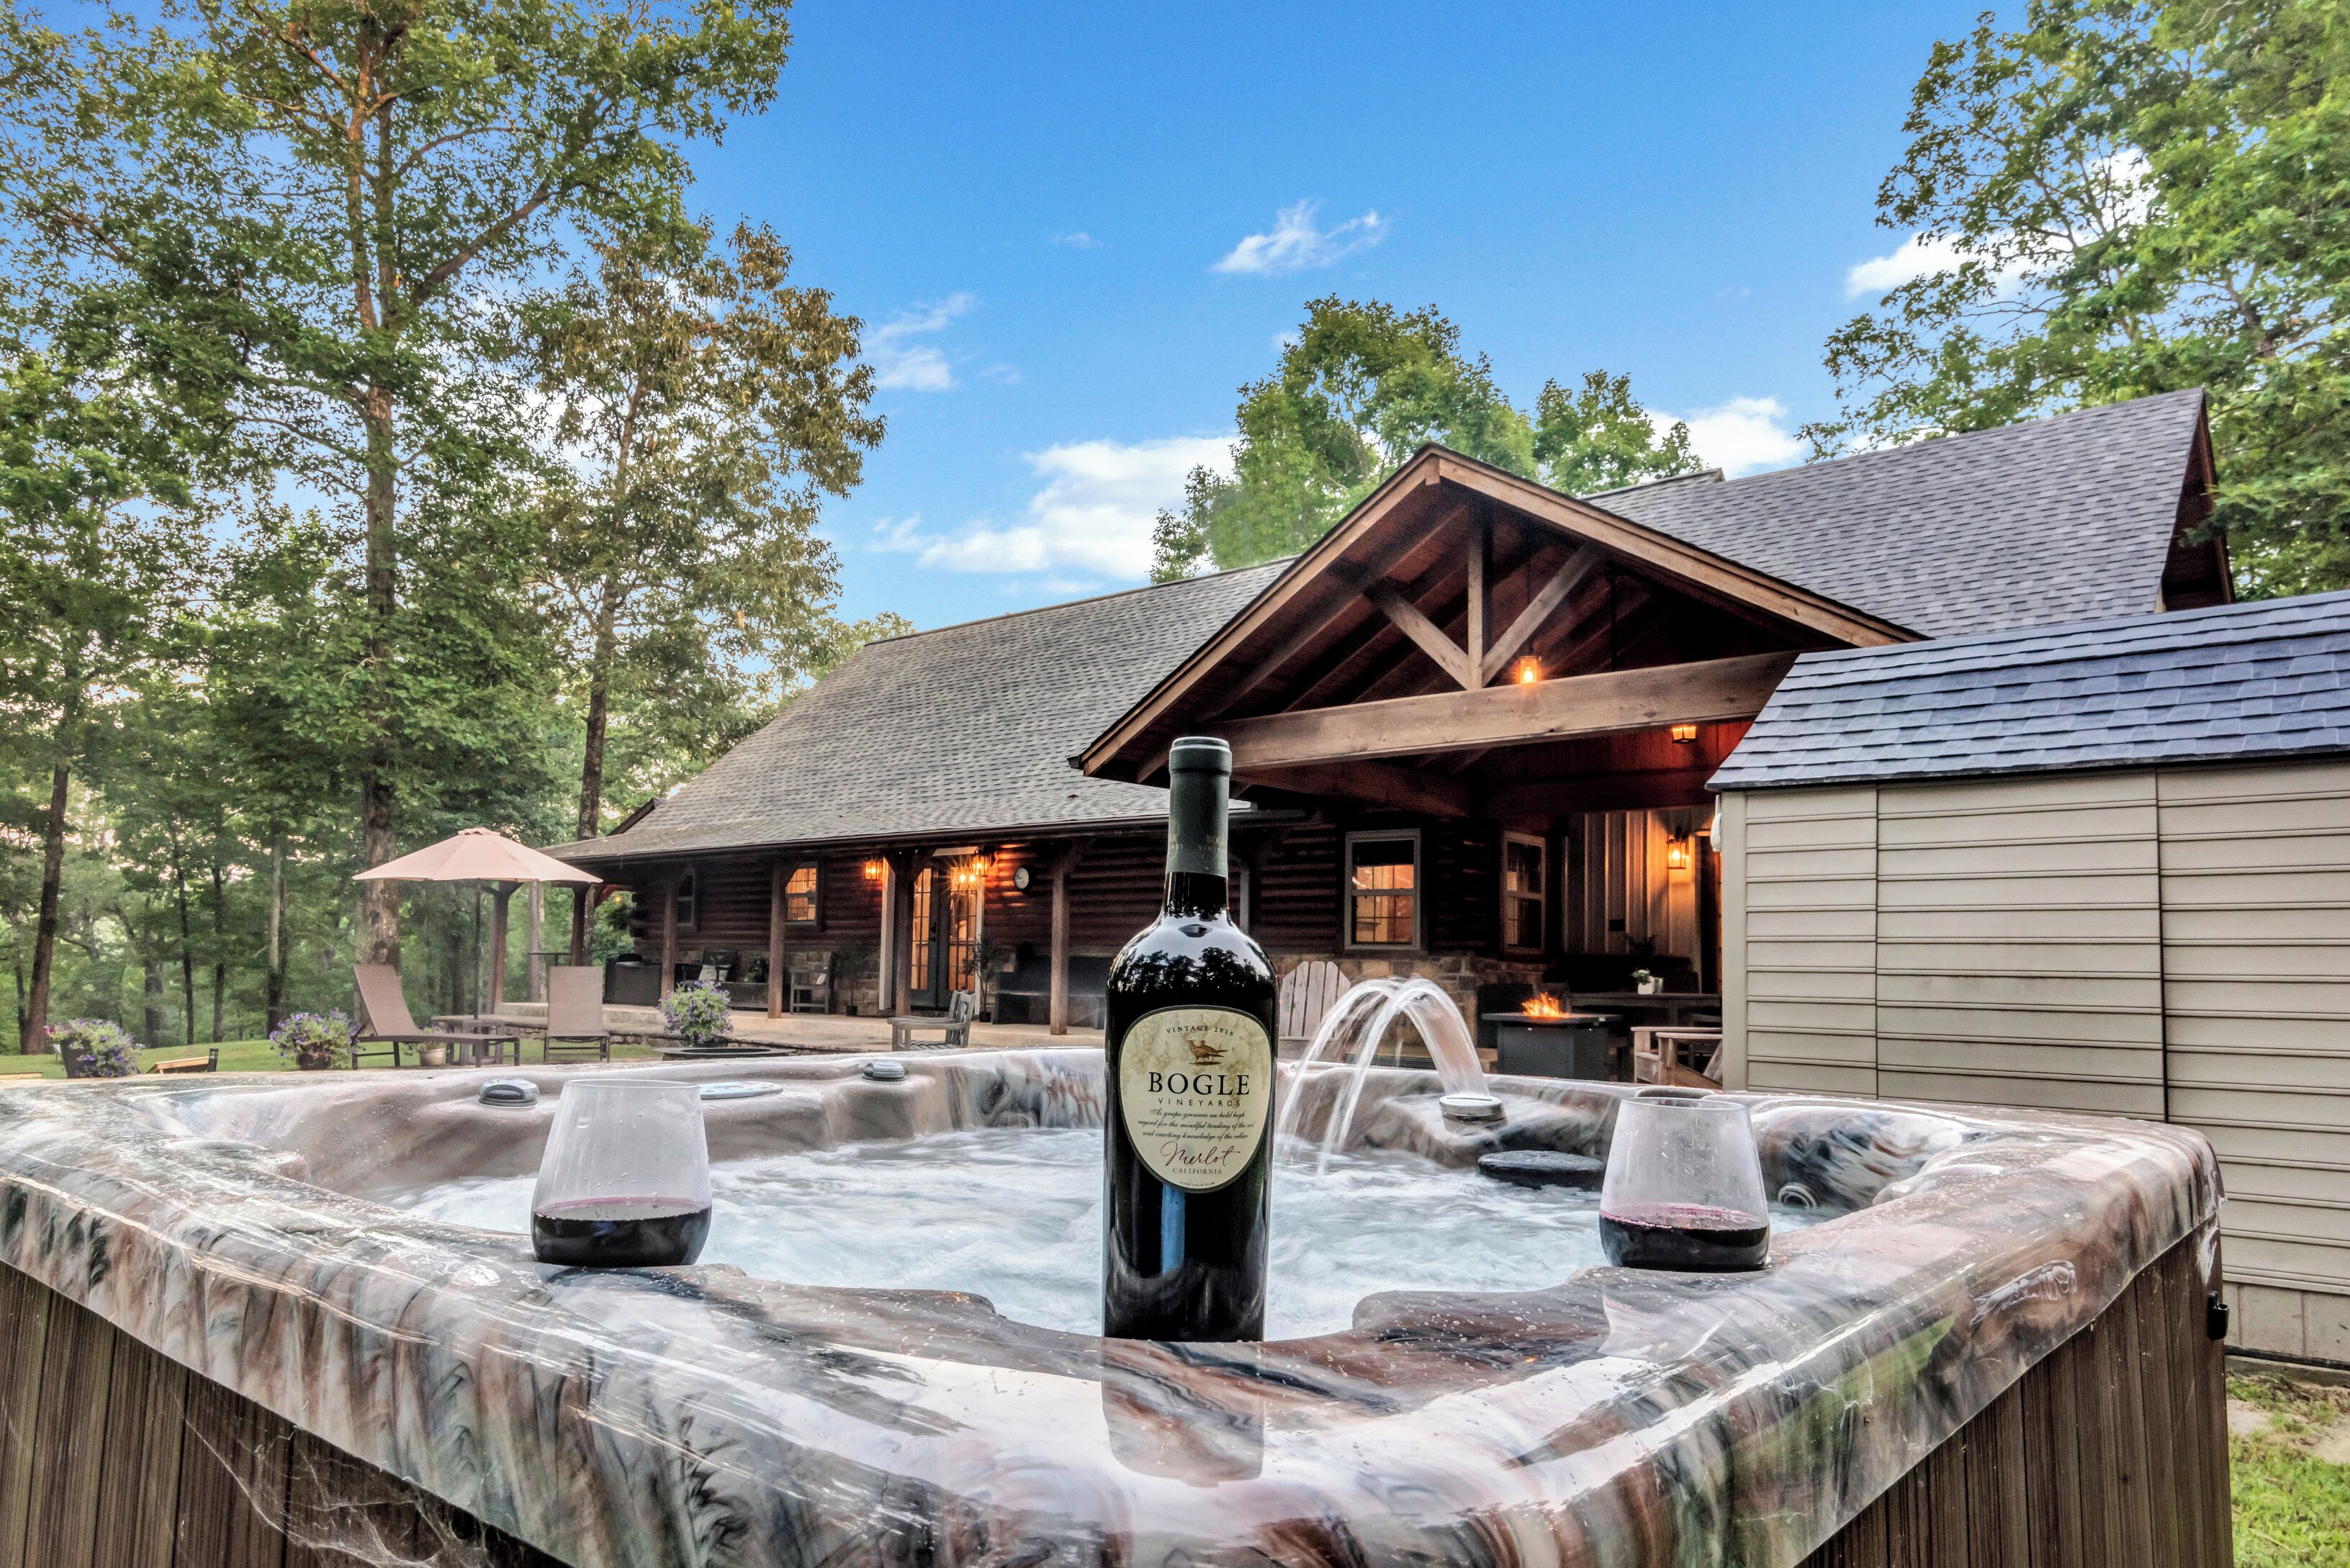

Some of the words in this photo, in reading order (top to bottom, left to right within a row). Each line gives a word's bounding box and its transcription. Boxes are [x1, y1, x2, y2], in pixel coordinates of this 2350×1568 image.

[1214, 1027, 1233, 1036] 2016
[1148, 1071, 1250, 1095] BOGLE
[1158, 1097, 1241, 1107] VINEYARDS
[1163, 1111, 1181, 1119] grape
[1233, 1111, 1245, 1120] high
[1138, 1119, 1157, 1128] regard
[1157, 1119, 1168, 1129] for
[1180, 1121, 1206, 1132] mindful
[1207, 1123, 1230, 1132] tending
[1230, 1122, 1240, 1131] of
[1155, 1131, 1181, 1140] exacting
[1182, 1131, 1216, 1141] knowledge
[1217, 1132, 1226, 1142] of
[1160, 1140, 1241, 1166] Merlot
